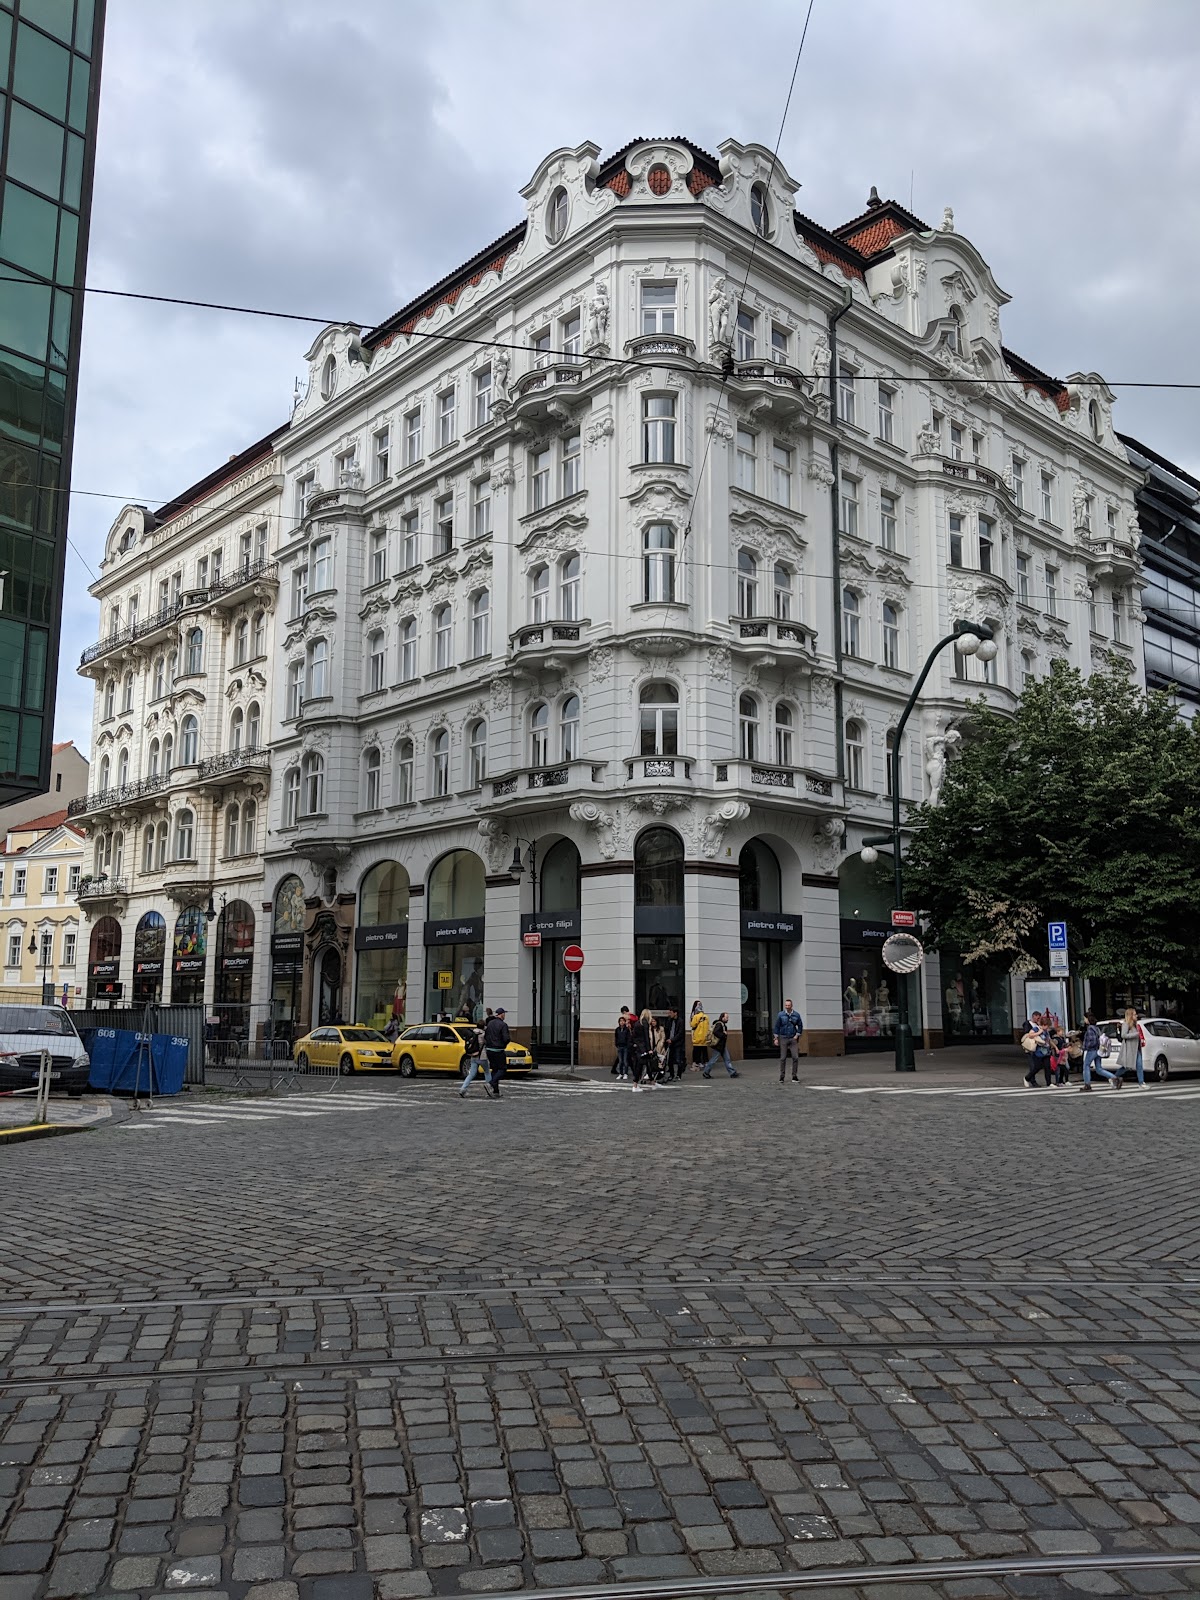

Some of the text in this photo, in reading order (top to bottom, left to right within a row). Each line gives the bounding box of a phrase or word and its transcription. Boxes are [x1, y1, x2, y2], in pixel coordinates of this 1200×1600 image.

[529, 920, 573, 931] petro filipi
[747, 921, 794, 932] pietro filipi
[436, 926, 473, 937] pietro filipi
[862, 929, 885, 937] pietro
[365, 932, 398, 942] pietro filipi
[97, 1029, 116, 1038] 608
[171, 1037, 189, 1047] 395
